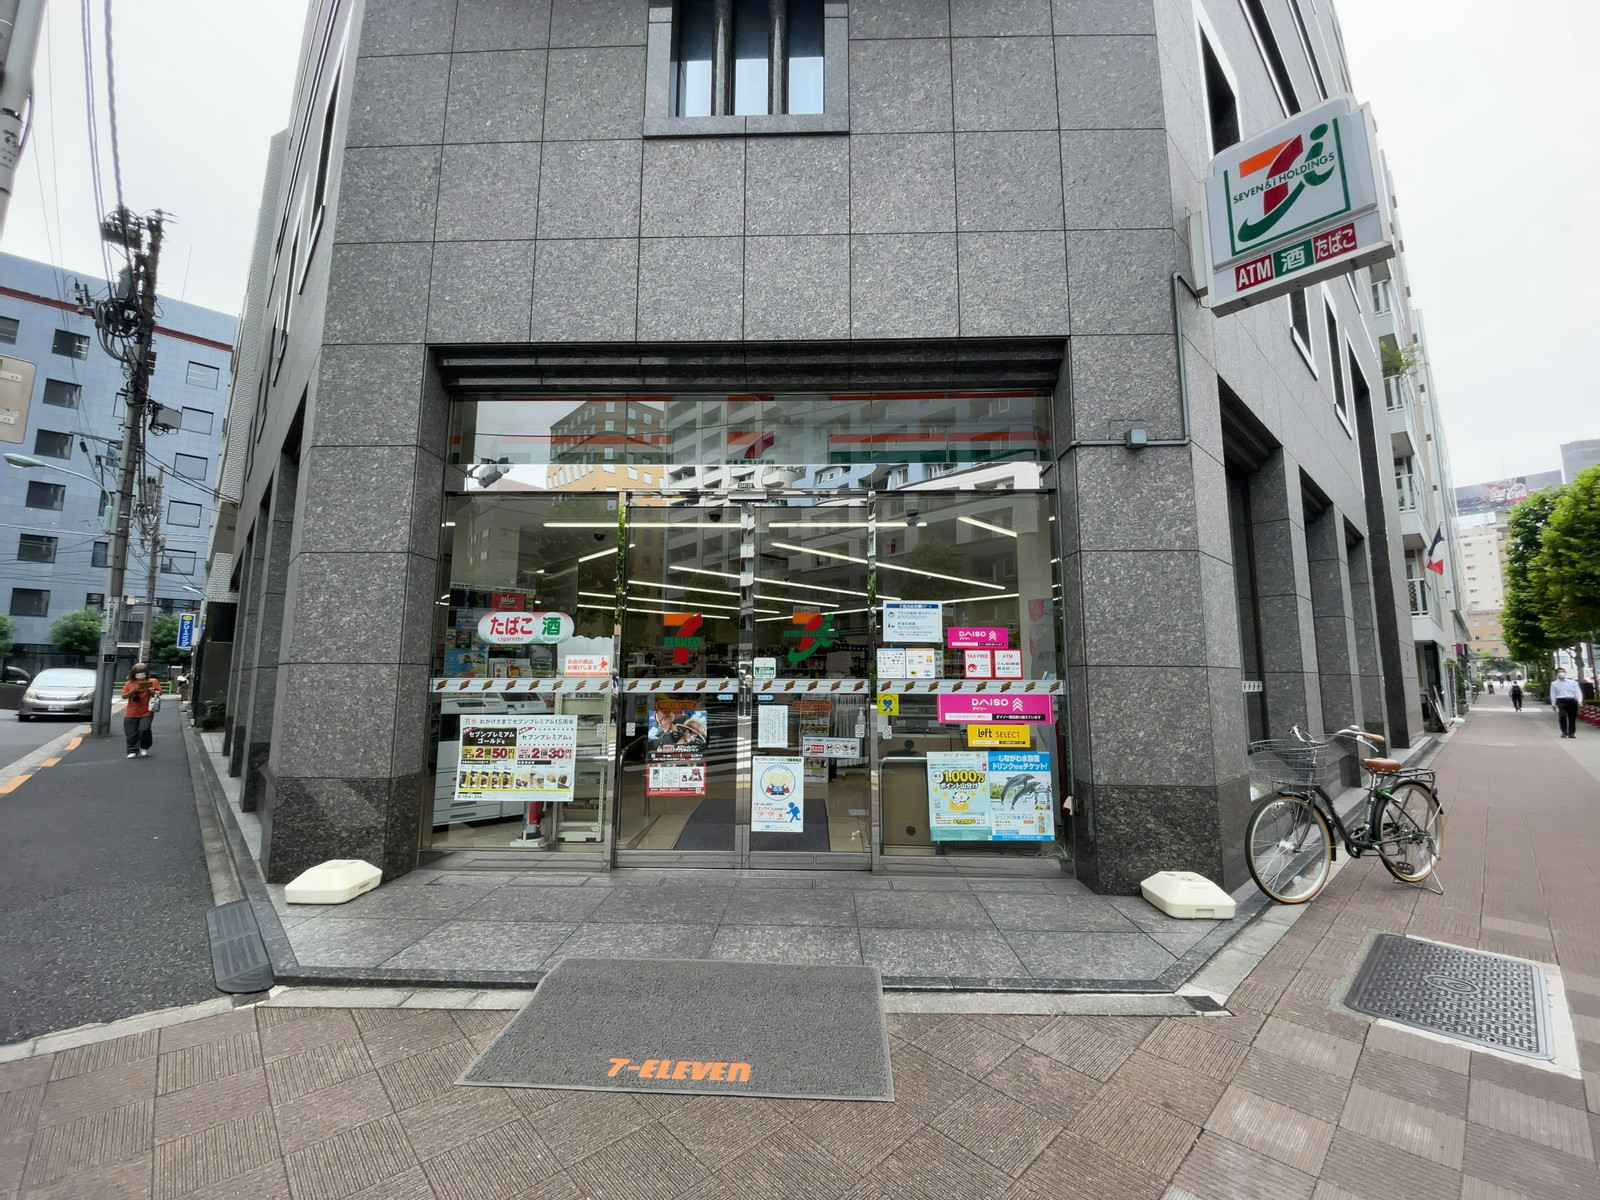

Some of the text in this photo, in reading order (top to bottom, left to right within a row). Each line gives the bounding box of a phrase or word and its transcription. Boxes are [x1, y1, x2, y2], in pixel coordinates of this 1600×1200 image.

[1278, 151, 1335, 184] HOLDINGS
[1315, 230, 1356, 258] たばこ
[1281, 246, 1306, 273] 酒
[1238, 260, 1272, 288] ATM
[490, 616, 533, 635] たばこ
[542, 616, 562, 636] 酒
[971, 698, 1009, 706] DAISO
[998, 754, 1040, 762] しながわ水族館
